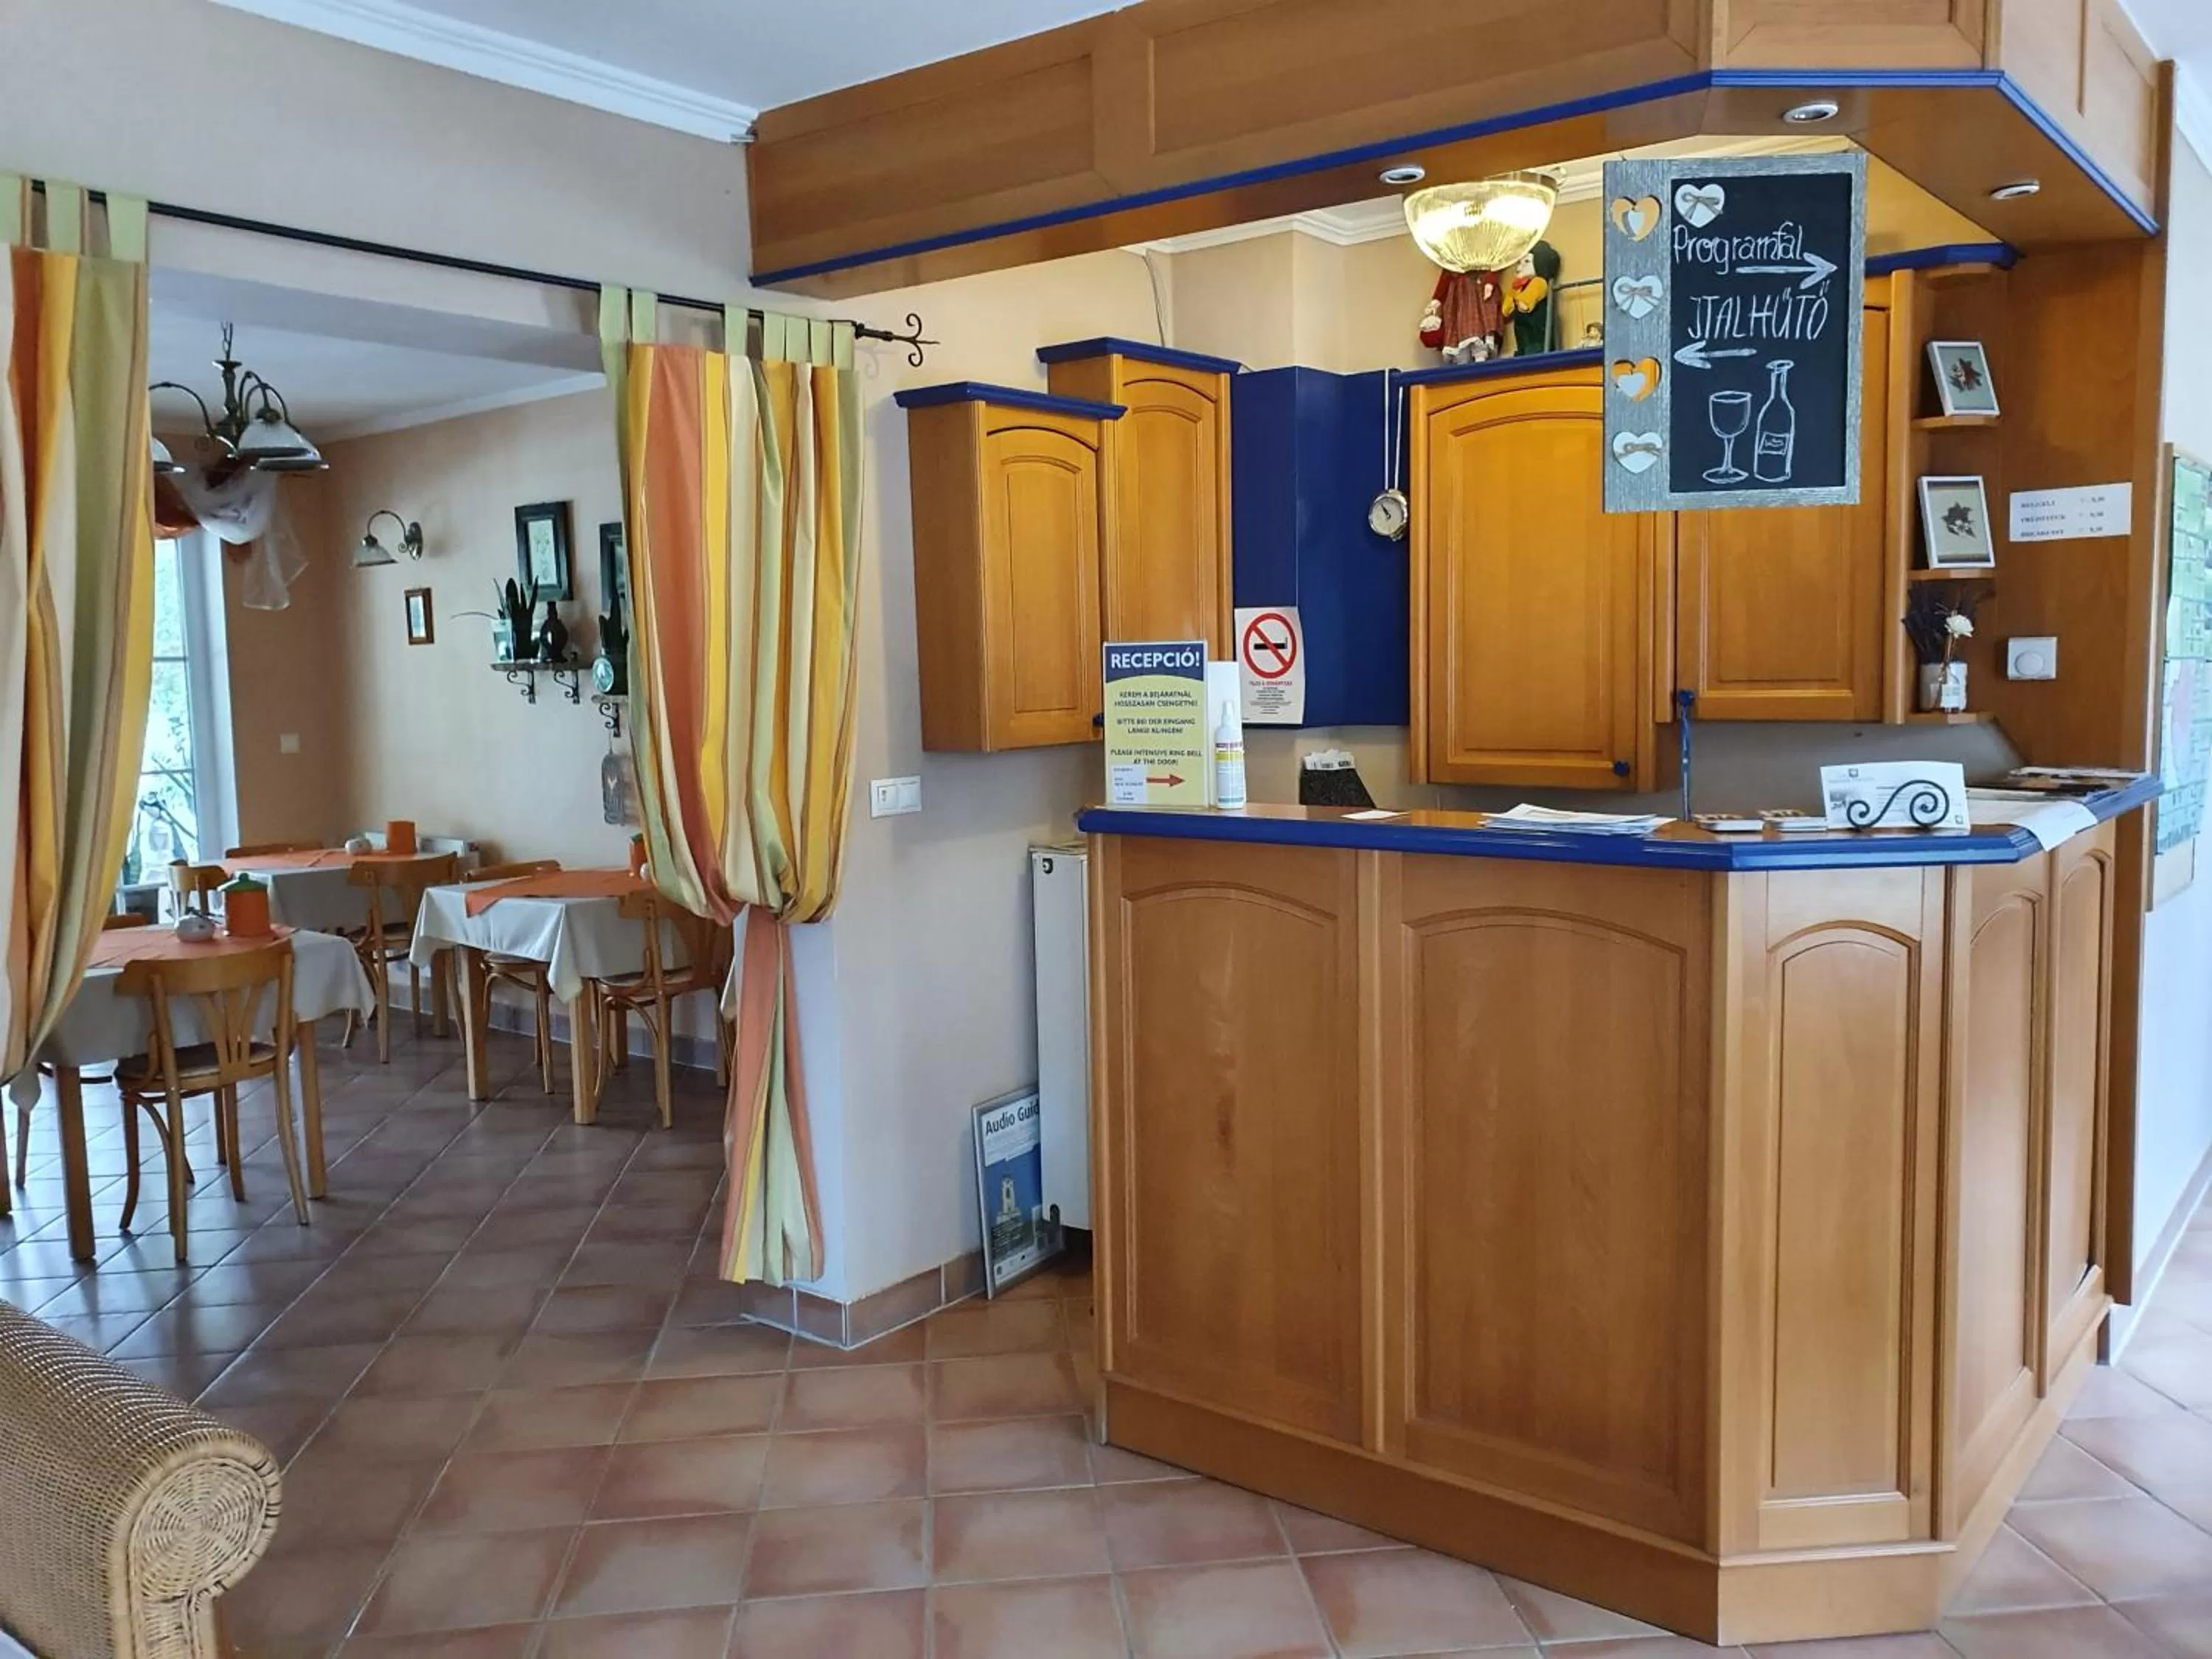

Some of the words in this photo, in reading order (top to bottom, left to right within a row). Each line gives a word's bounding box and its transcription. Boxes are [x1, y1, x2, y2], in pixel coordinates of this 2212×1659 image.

[1111, 647, 1200, 669] RECEPCIÓ!
[986, 1110, 1015, 1135] Audio
[1017, 1098, 1040, 1121] Guid
